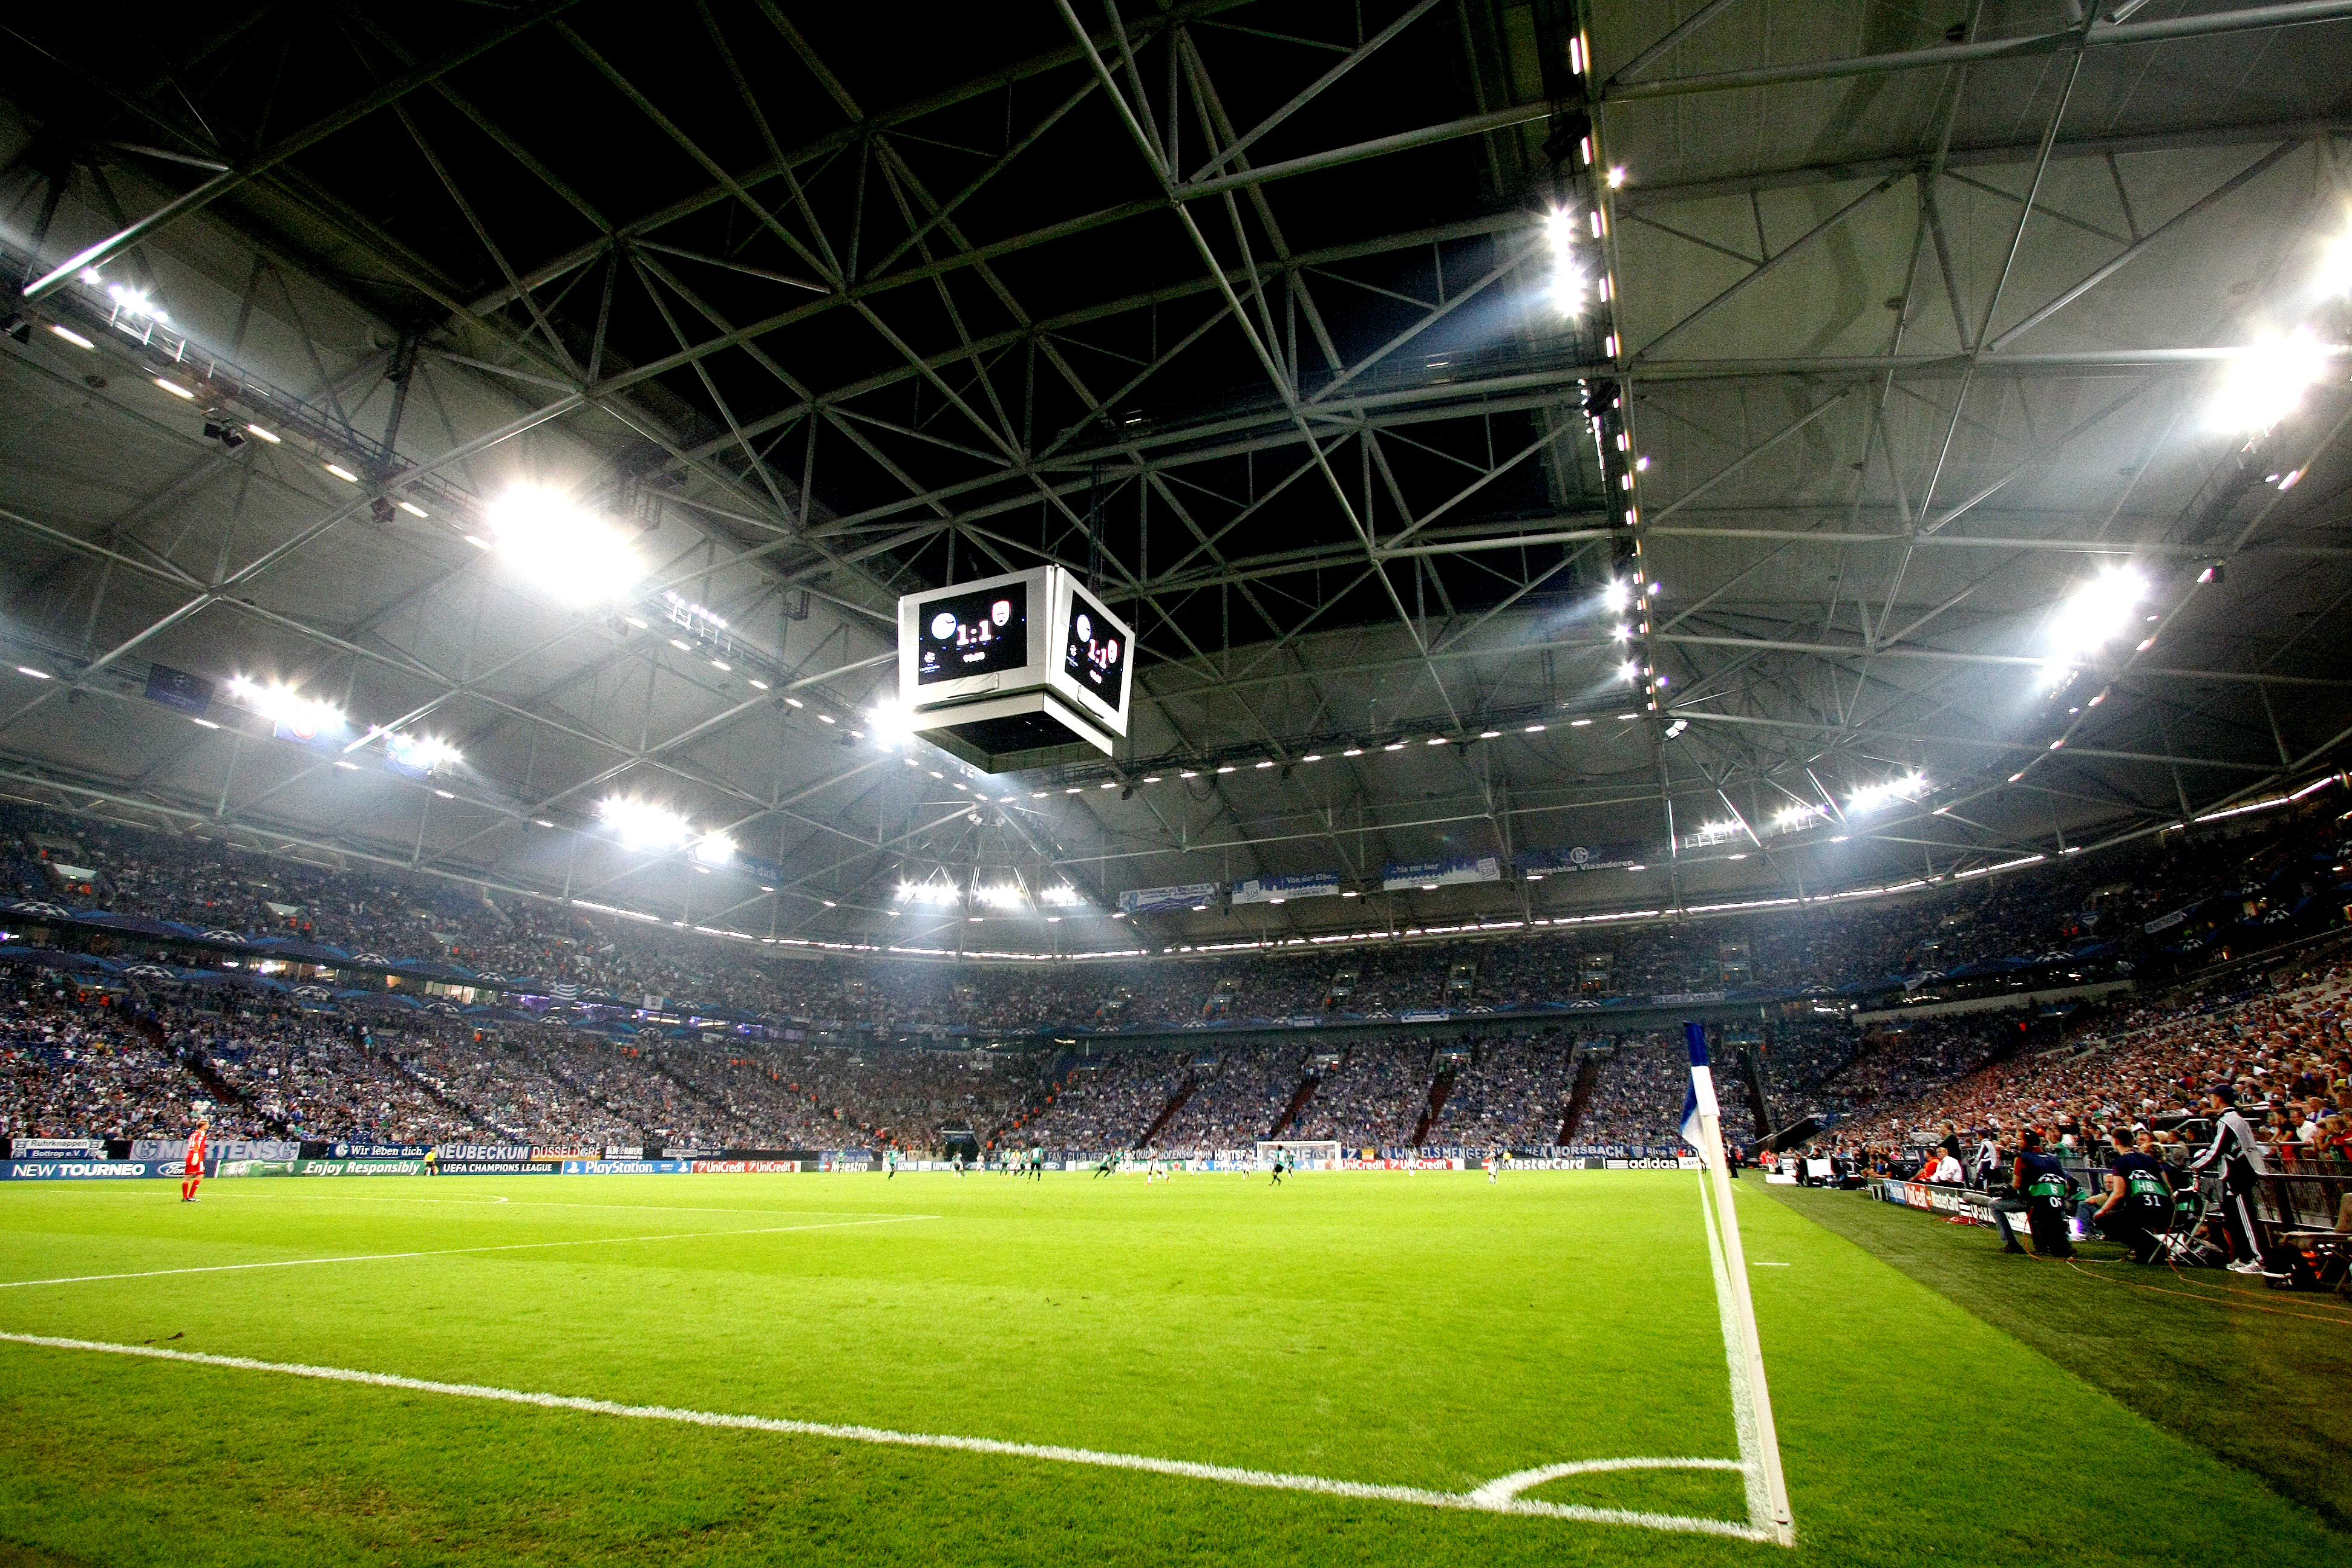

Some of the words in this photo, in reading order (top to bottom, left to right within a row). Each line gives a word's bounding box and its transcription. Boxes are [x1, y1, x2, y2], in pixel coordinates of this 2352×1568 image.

[956, 619, 991, 646] 1:1
[1088, 638, 1107, 669] 1:1
[1526, 865, 1577, 875] Königsblau
[1579, 860, 1635, 871] Vlaanderen
[31, 1140, 87, 1148] Ruhrknappen
[157, 1140, 278, 1160] MRTENS
[350, 1145, 370, 1155] Wir
[372, 1145, 399, 1155] leben
[436, 1145, 529, 1160] NEUBECKUM
[1550, 1146, 1624, 1158] MORSBACH
[305, 1161, 344, 1176] Enjoy
[346, 1160, 421, 1176] Responsibly
[443, 1164, 467, 1172] UEFA
[469, 1164, 520, 1172] CHAMPIONS
[521, 1164, 553, 1172] LEAGUE
[585, 1161, 653, 1175] PlayStation
[707, 1161, 745, 1173] UniCredit
[757, 1161, 791, 1172] UniCredit
[831, 1161, 868, 1172] Maestro
[1341, 1159, 1385, 1170] UniCredit
[1505, 1157, 1586, 1170] MasterCard
[1628, 1157, 1677, 1169] adidas
[13, 1164, 57, 1177] NEW
[59, 1163, 146, 1176] TOURNEO
[2138, 1183, 2154, 1192] HB
[2143, 1195, 2161, 1207] 31
